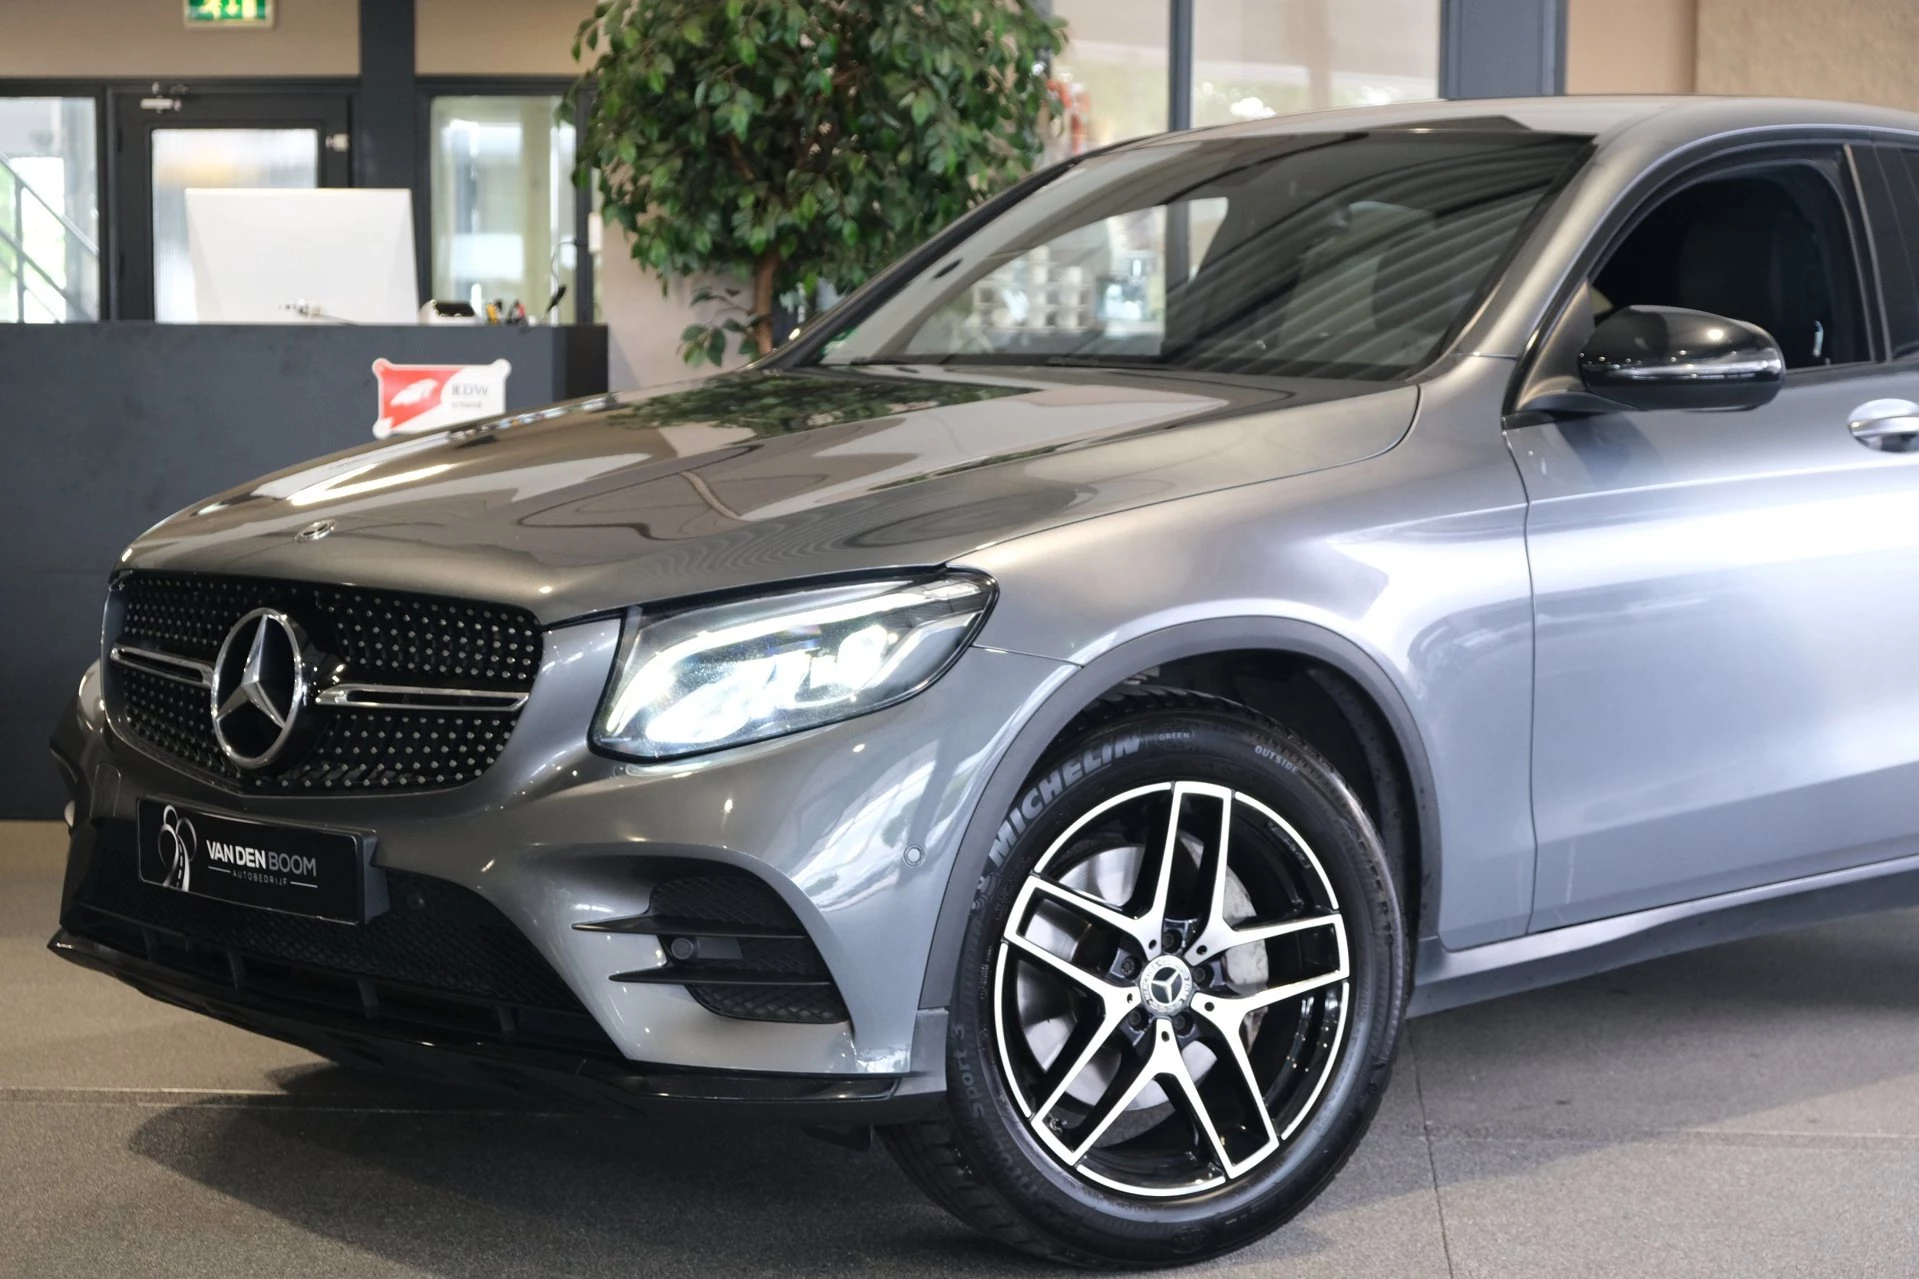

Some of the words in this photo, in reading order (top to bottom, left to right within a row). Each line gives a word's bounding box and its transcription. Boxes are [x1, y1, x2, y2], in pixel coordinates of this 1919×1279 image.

[1158, 731, 1190, 741] GREEN
[1254, 745, 1298, 774] OUTSIDE
[988, 735, 1140, 868] MICHELIN
[206, 839, 234, 864] VAN
[235, 845, 266, 870] DEN
[267, 851, 317, 877] BOOM
[232, 870, 287, 886] AUTOBEDRIJF
